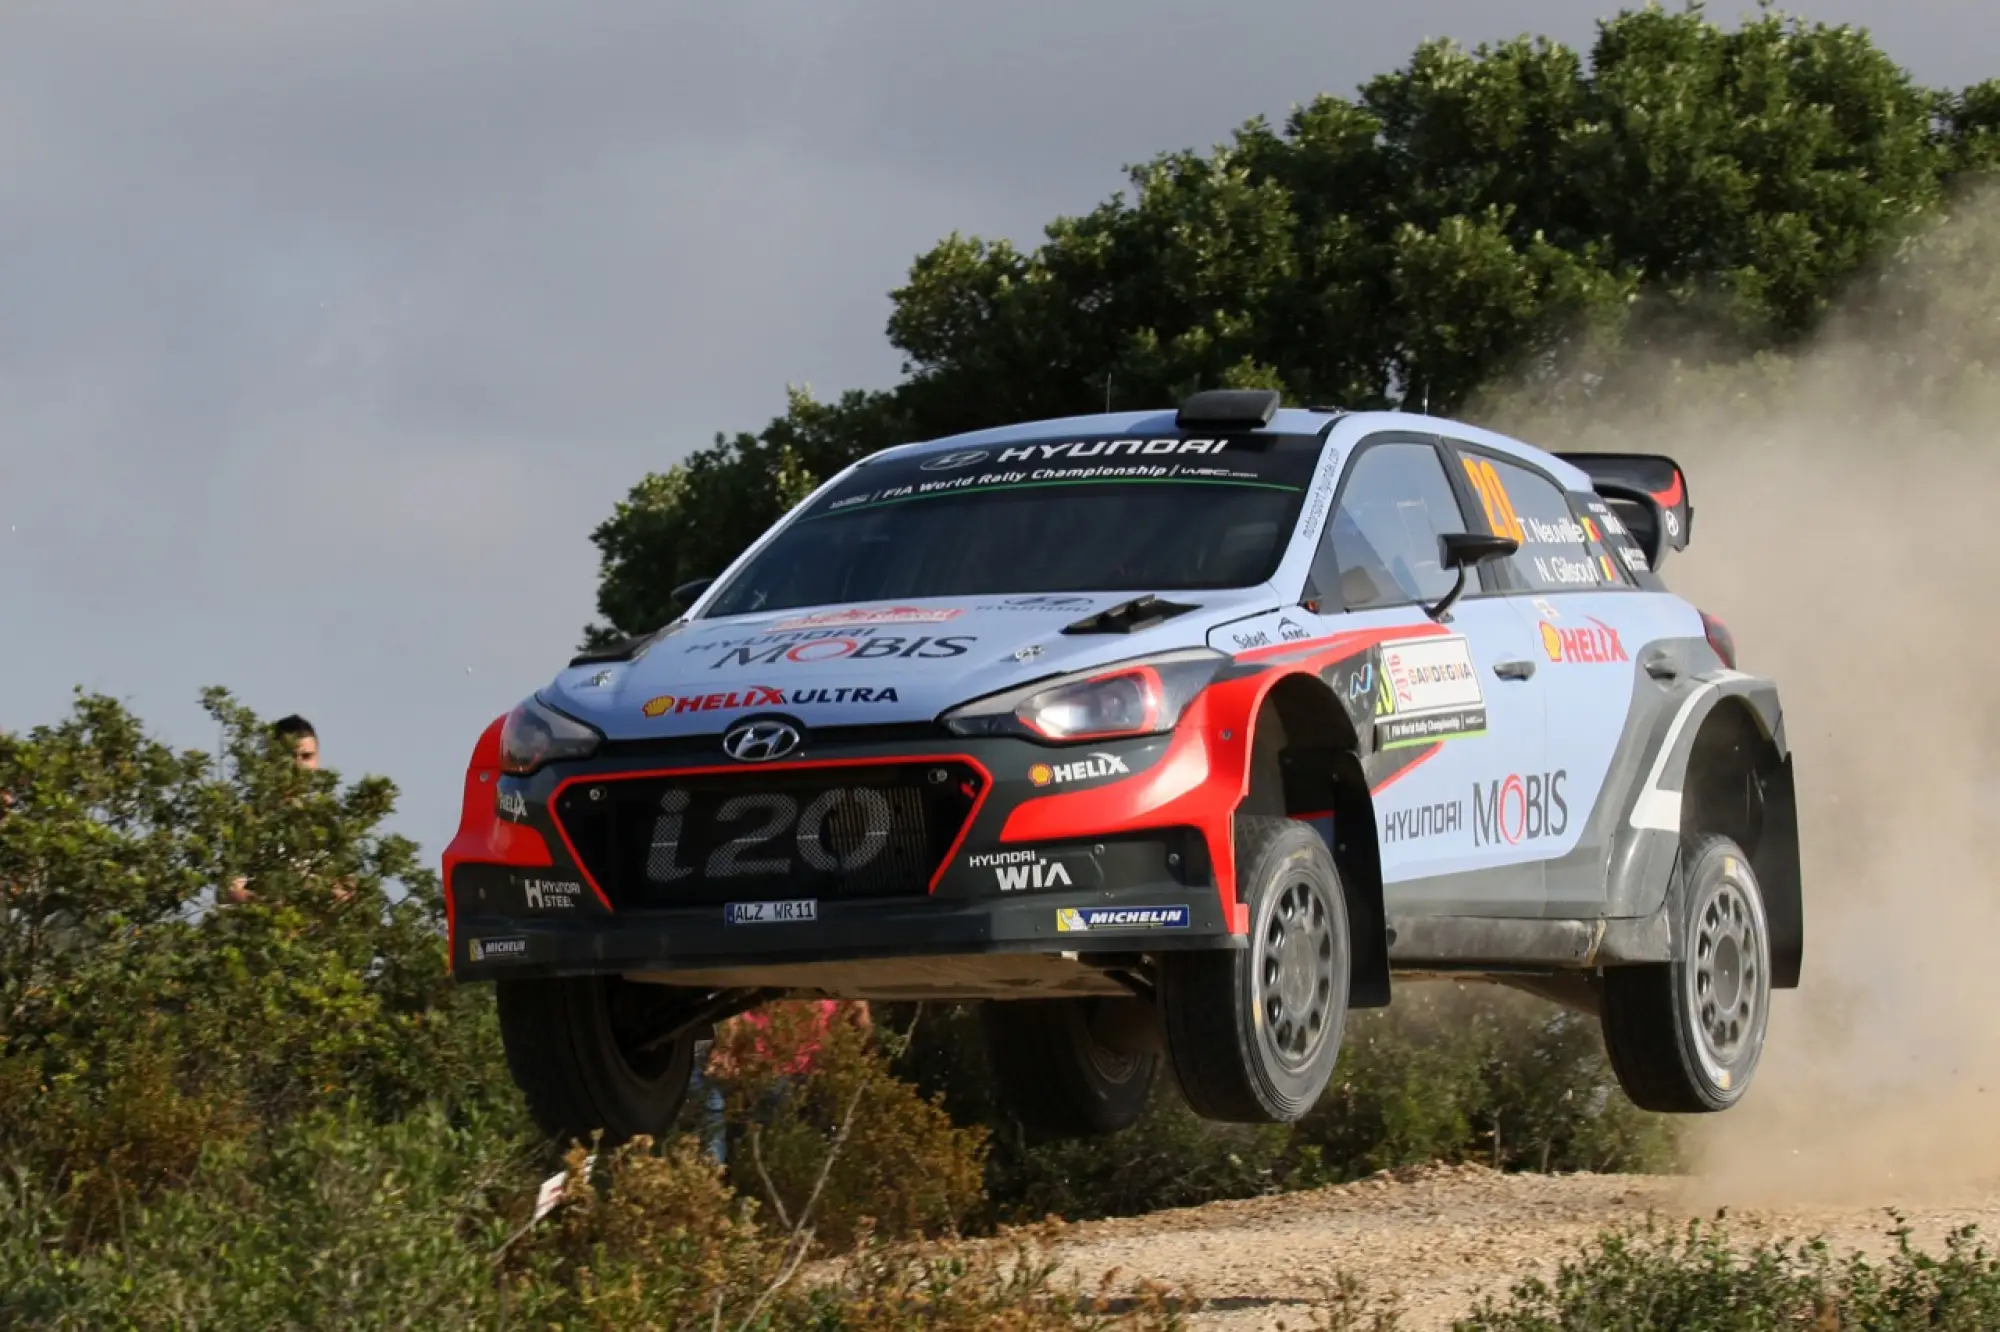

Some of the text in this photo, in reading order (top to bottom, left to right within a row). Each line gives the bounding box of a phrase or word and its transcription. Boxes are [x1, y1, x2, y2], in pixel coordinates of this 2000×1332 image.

[996, 438, 1229, 463] HYUNDAI
[882, 486, 913, 499] FIA
[919, 475, 975, 492] World
[978, 471, 1027, 486] Rally
[1032, 464, 1168, 483] Championship
[1528, 516, 1585, 544] Neuville
[1533, 556, 1555, 582] N.
[684, 628, 878, 653] HYUNDAI
[1558, 613, 1629, 663] HELIX
[709, 636, 977, 670] MOBIS
[1388, 654, 1412, 703] 2016
[1409, 662, 1473, 685] SARDEGNA
[673, 686, 899, 715] HELIX ULTRA
[1051, 752, 1130, 783] HELIX
[1384, 770, 1568, 847] HYUNDAI MOBIS
[647, 788, 891, 883] i20
[969, 850, 1036, 867] HYUNDAI
[541, 880, 581, 895] HYUNDAI
[996, 859, 1072, 890] WIA
[544, 895, 575, 908] STEEL
[735, 903, 763, 921] ALZ
[1090, 910, 1182, 924] MICHELIN
